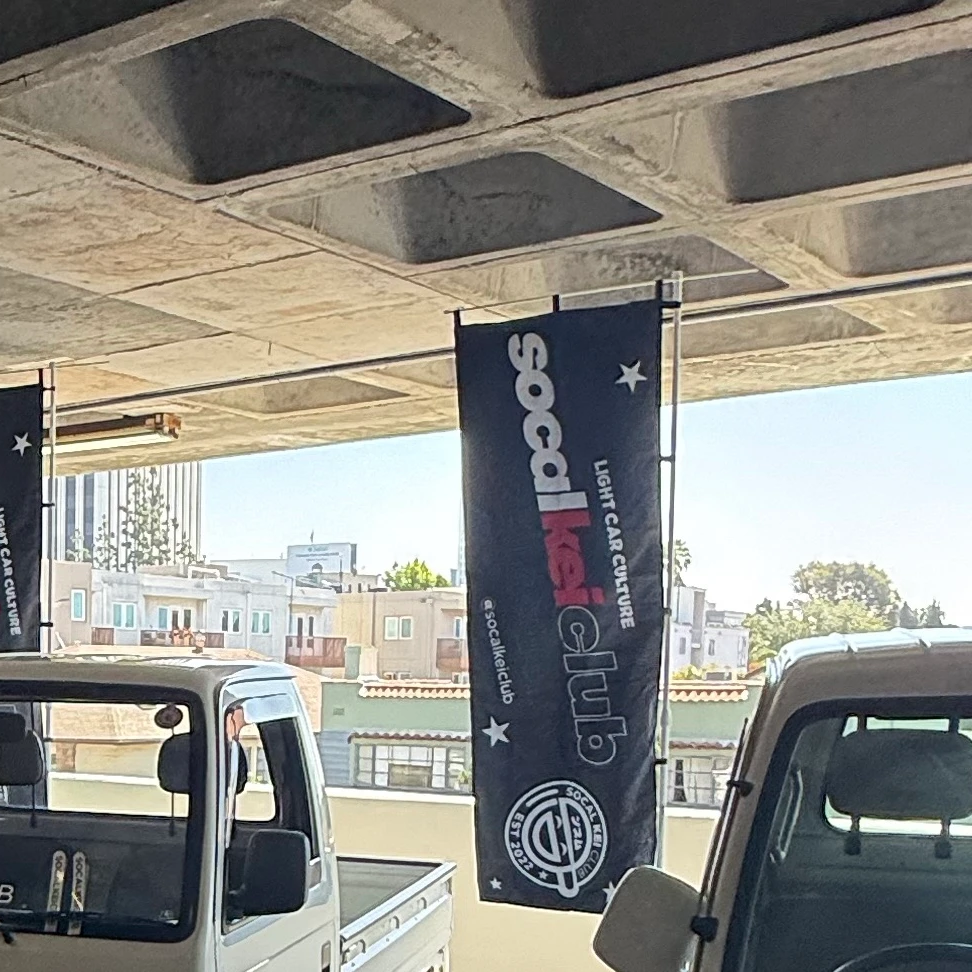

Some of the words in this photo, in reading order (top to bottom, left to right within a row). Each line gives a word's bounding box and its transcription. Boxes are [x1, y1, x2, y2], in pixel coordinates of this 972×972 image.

[593, 459, 616, 509] LIGHT
[604, 512, 624, 552] CAR
[0, 547, 13, 577] CAR
[4, 579, 22, 636] CULTURE
[612, 553, 636, 630] CULTURE
[481, 597, 515, 704] @socalkeiclub
[565, 786, 598, 823] SOCAL
[509, 812, 525, 838] EST
[592, 823, 603, 848] KEI
[510, 841, 534, 871] 2022
[577, 849, 600, 879] CLUB
